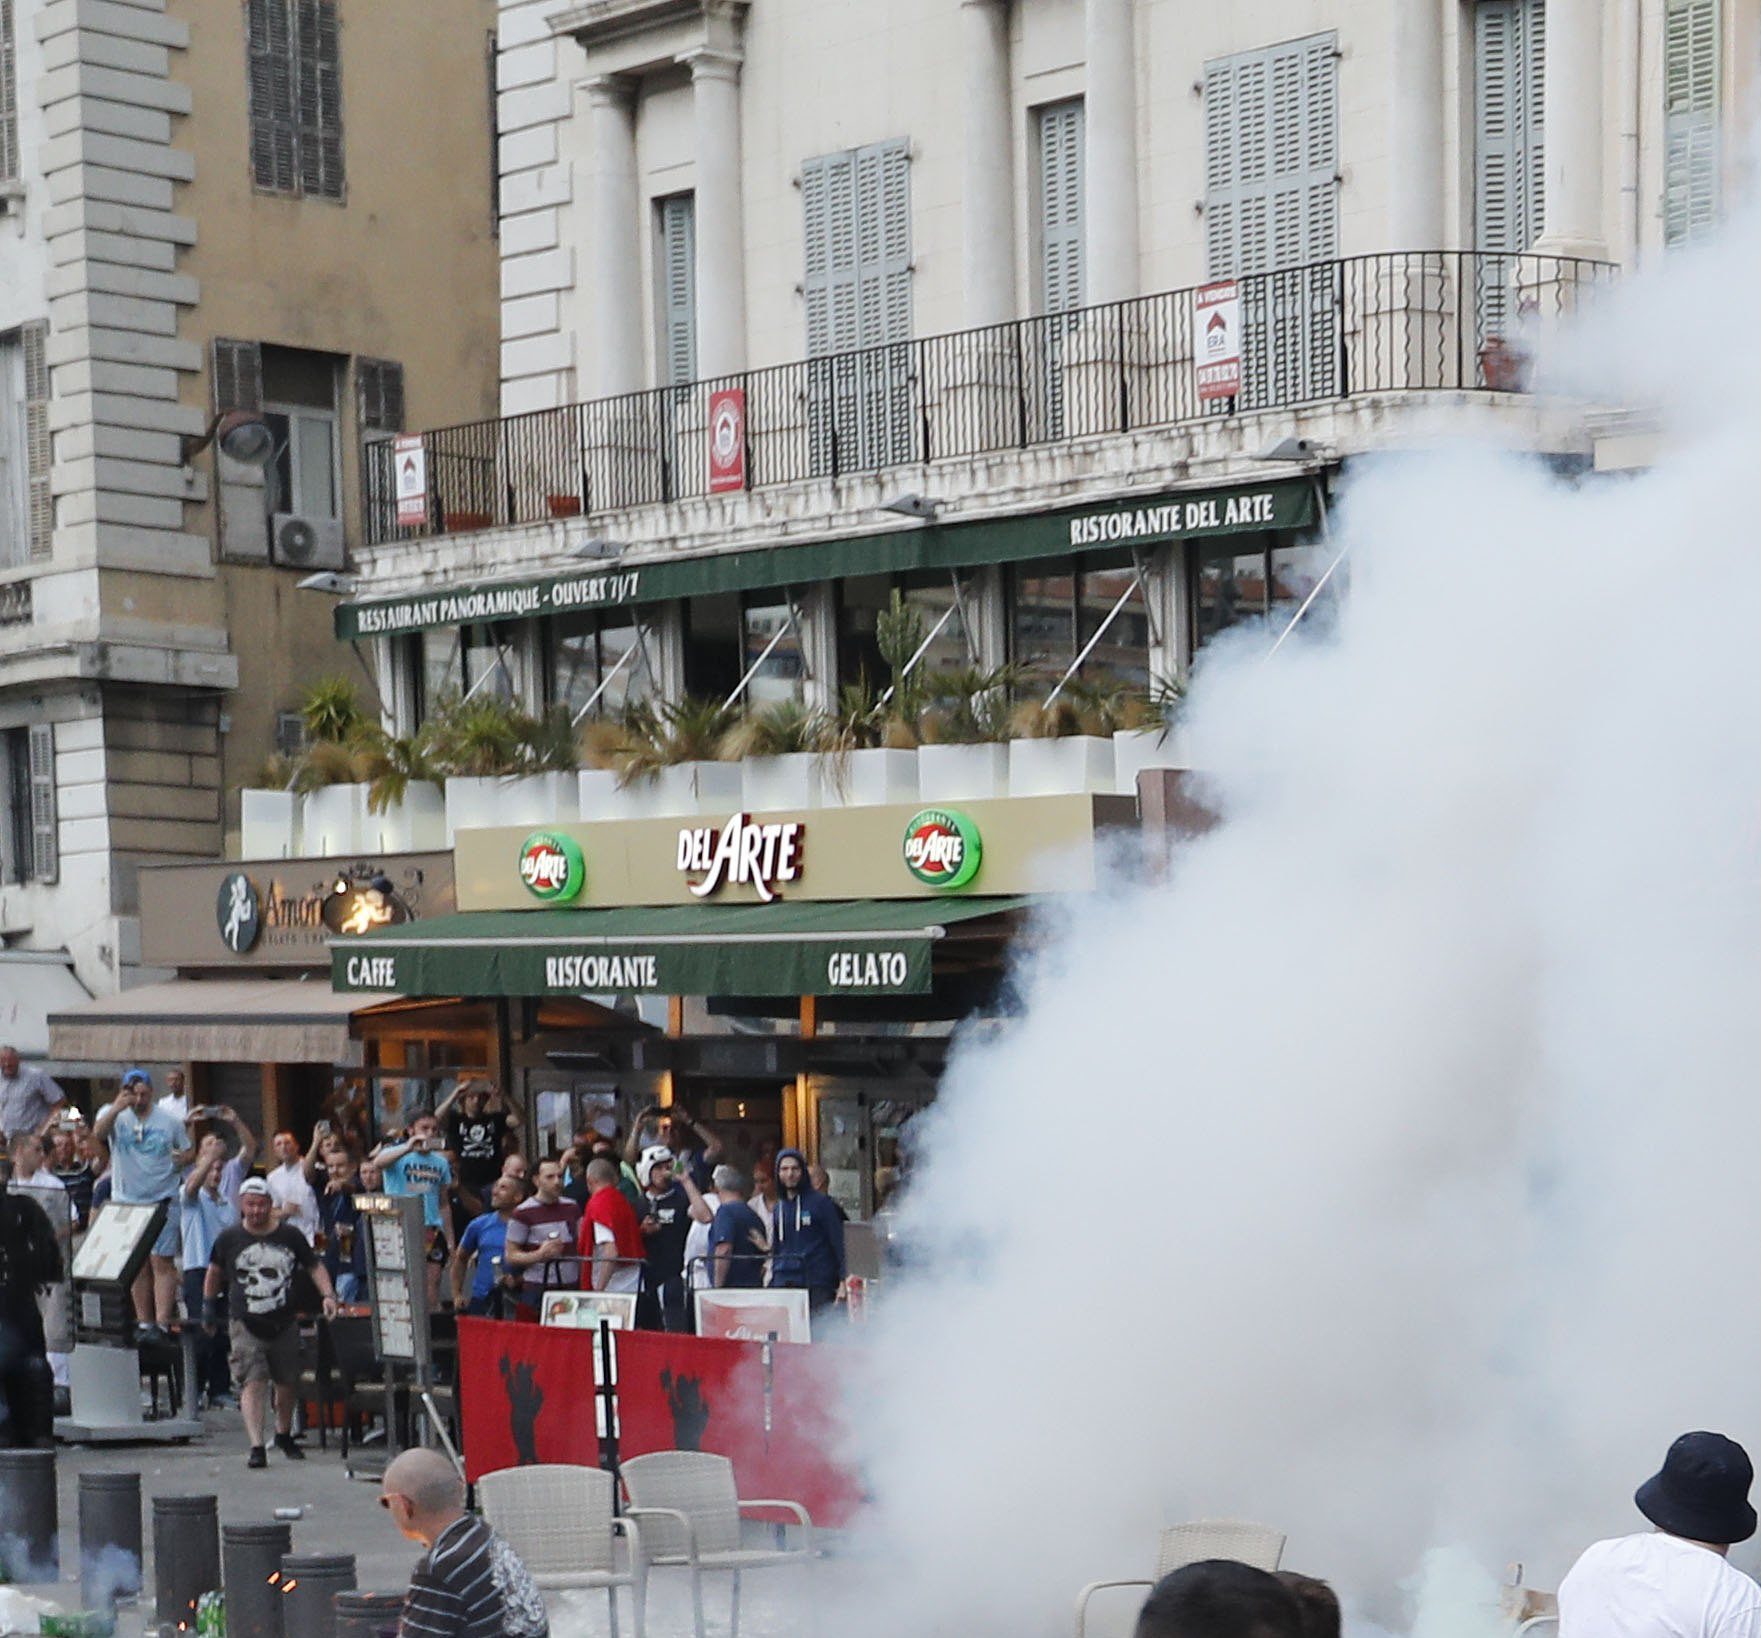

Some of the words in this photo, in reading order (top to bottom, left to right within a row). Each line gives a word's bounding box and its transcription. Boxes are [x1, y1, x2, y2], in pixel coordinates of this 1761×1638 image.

[1070, 505, 1181, 545] RISTORANTE
[1185, 501, 1220, 530] DEL
[1225, 493, 1274, 525] ARTE
[358, 601, 437, 632] RESTAURANT
[440, 586, 540, 622] PANORAMIQUE
[551, 577, 606, 606] OUVERT
[687, 812, 800, 901] ARTE
[346, 956, 396, 987] CAFFE
[546, 955, 658, 988] RISTORANTE
[828, 952, 908, 987] GELATO
